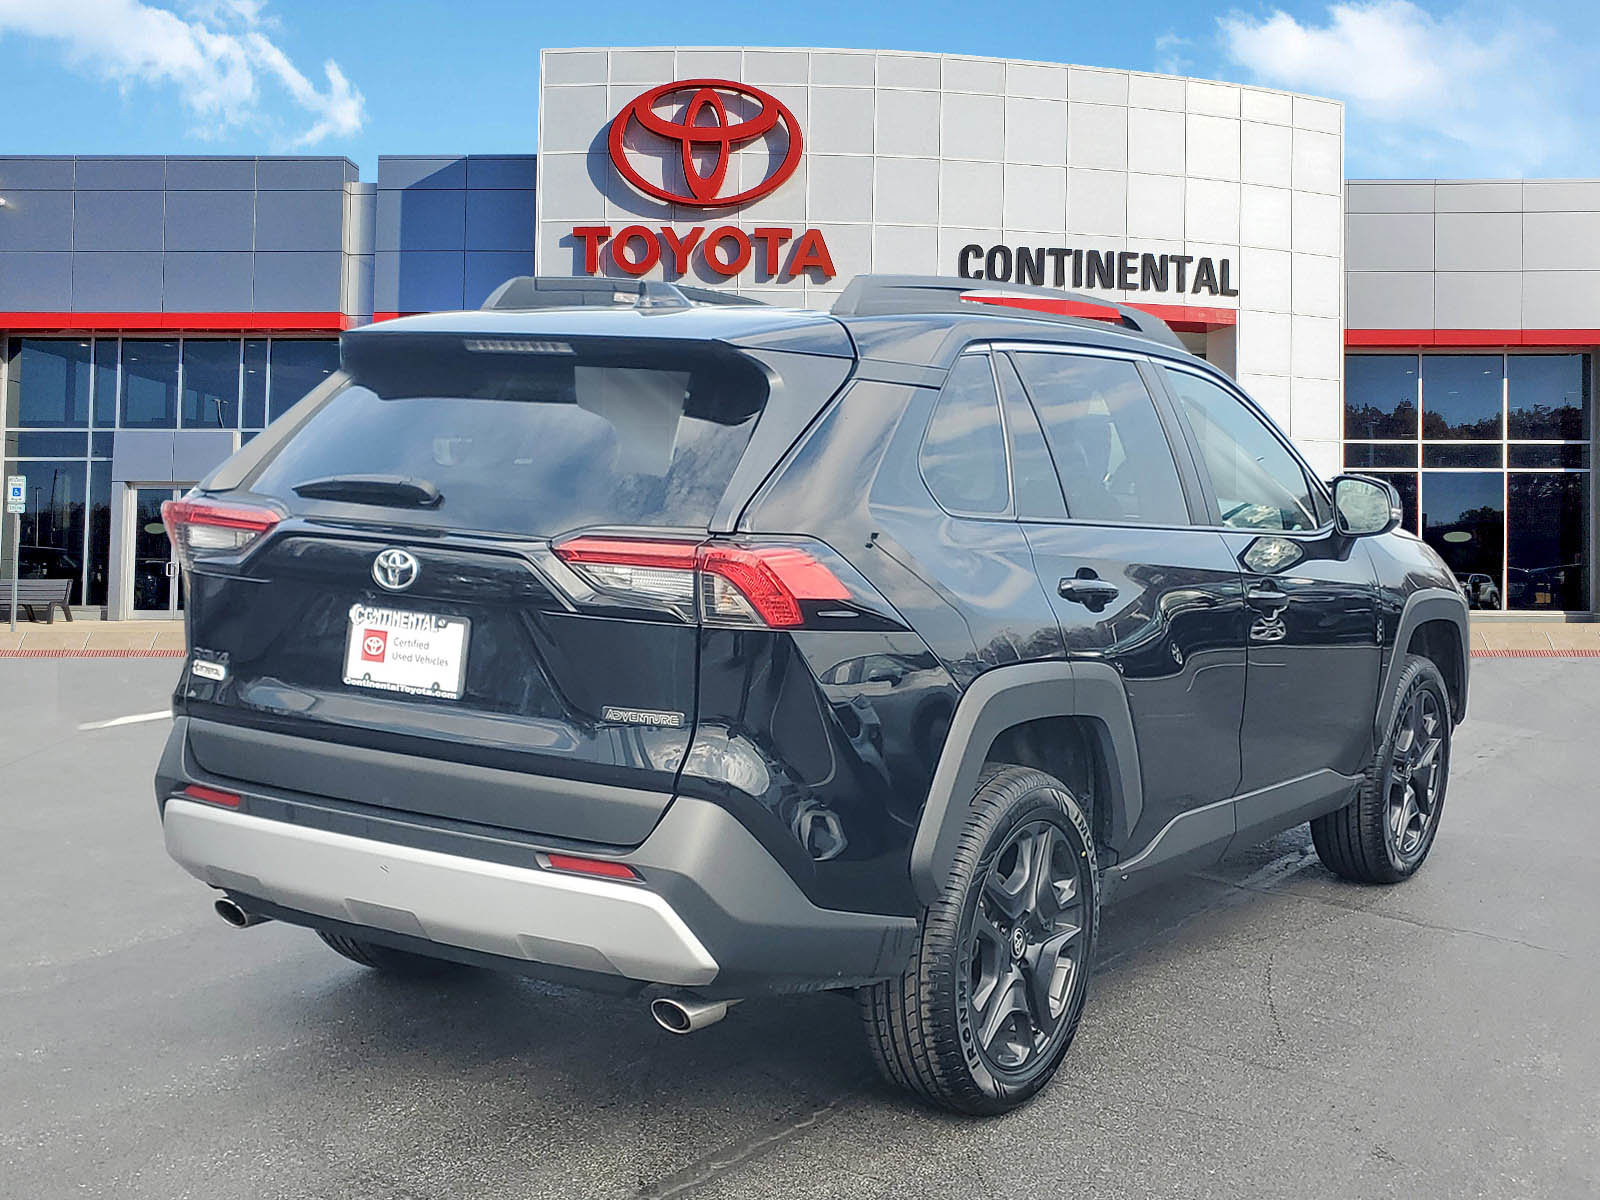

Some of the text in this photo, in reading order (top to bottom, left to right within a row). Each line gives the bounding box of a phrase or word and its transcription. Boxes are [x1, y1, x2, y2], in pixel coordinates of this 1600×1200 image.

[572, 225, 837, 277] TOYOTA
[958, 243, 1239, 297] CONTINENTAL
[354, 606, 438, 632] CONTINENTAL
[393, 636, 430, 651] Certified
[391, 651, 449, 667] Used Vehicles
[343, 677, 457, 699] ContinentalToyota.com
[605, 709, 680, 726] ADVENTURE
